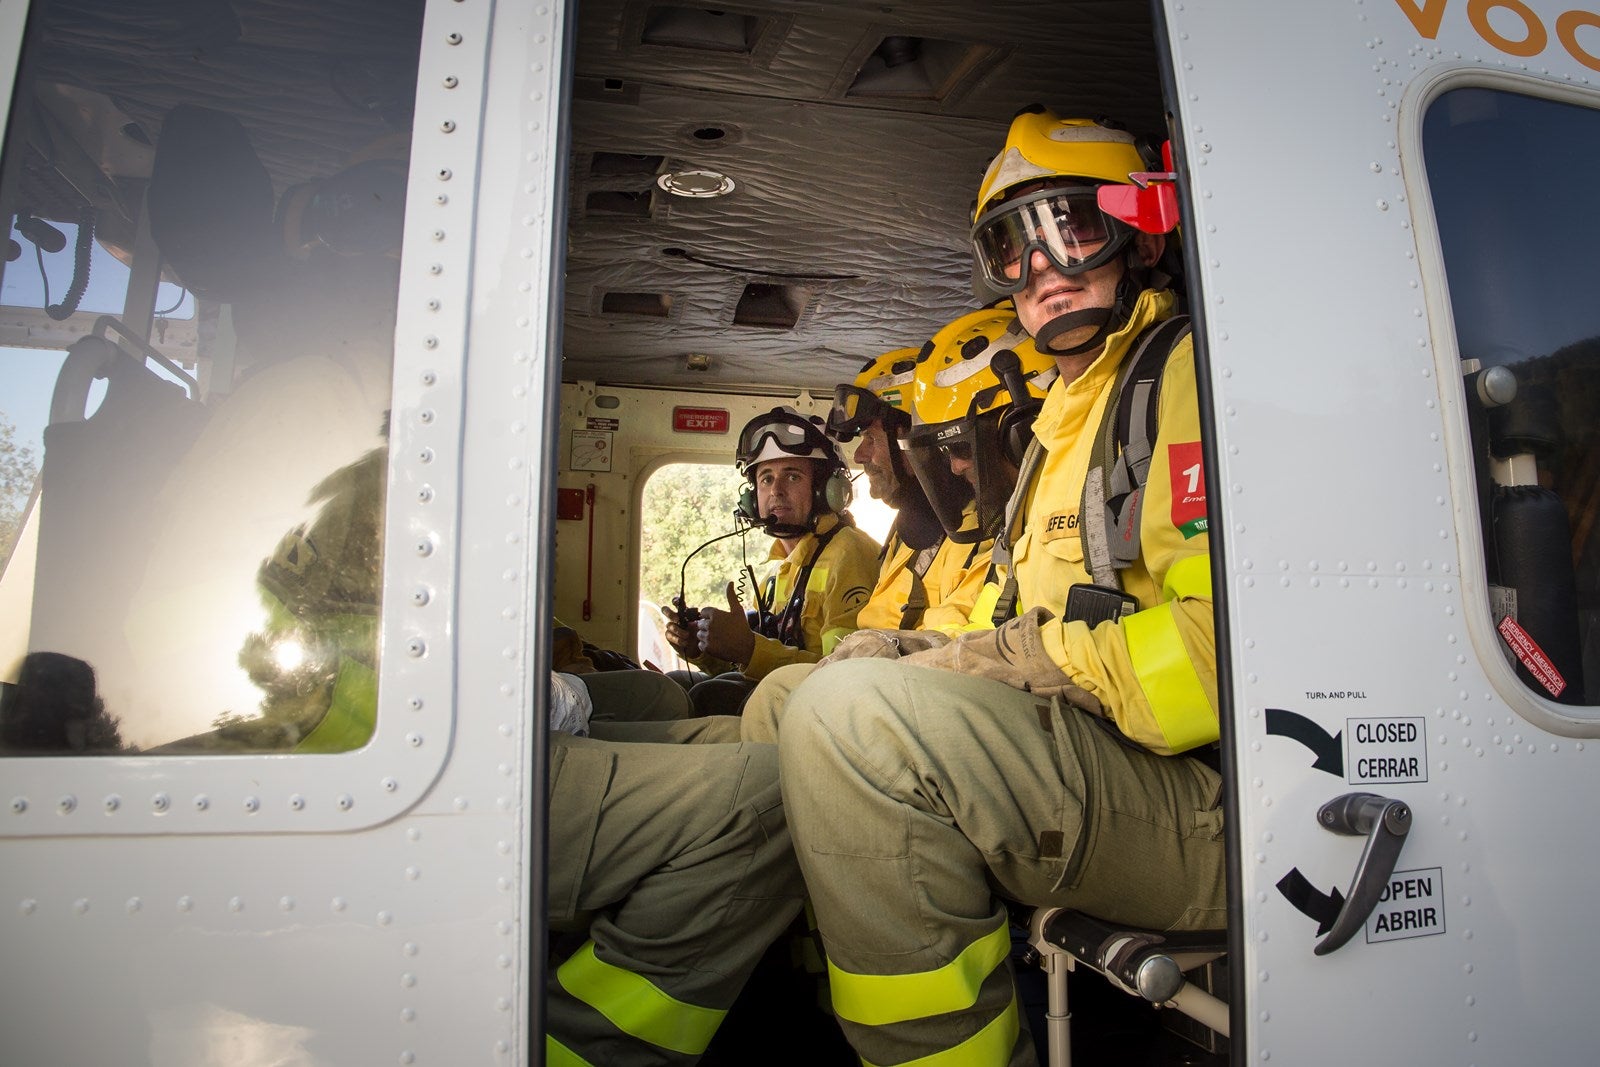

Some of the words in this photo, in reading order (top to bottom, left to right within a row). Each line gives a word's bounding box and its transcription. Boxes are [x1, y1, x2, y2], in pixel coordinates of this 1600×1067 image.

[686, 419, 717, 428] EXIT
[1499, 625, 1513, 642] PUSH
[1510, 641, 1525, 659] HERE
[1523, 658, 1548, 685] EMPUJAR
[1504, 617, 1533, 652] EMERGENCY
[1533, 652, 1564, 688] EMERGENCIA
[1347, 691, 1367, 699] PULL
[1356, 723, 1417, 743] CLOSED
[1357, 757, 1419, 778] CERRAR
[1375, 907, 1437, 933] ABRIR
